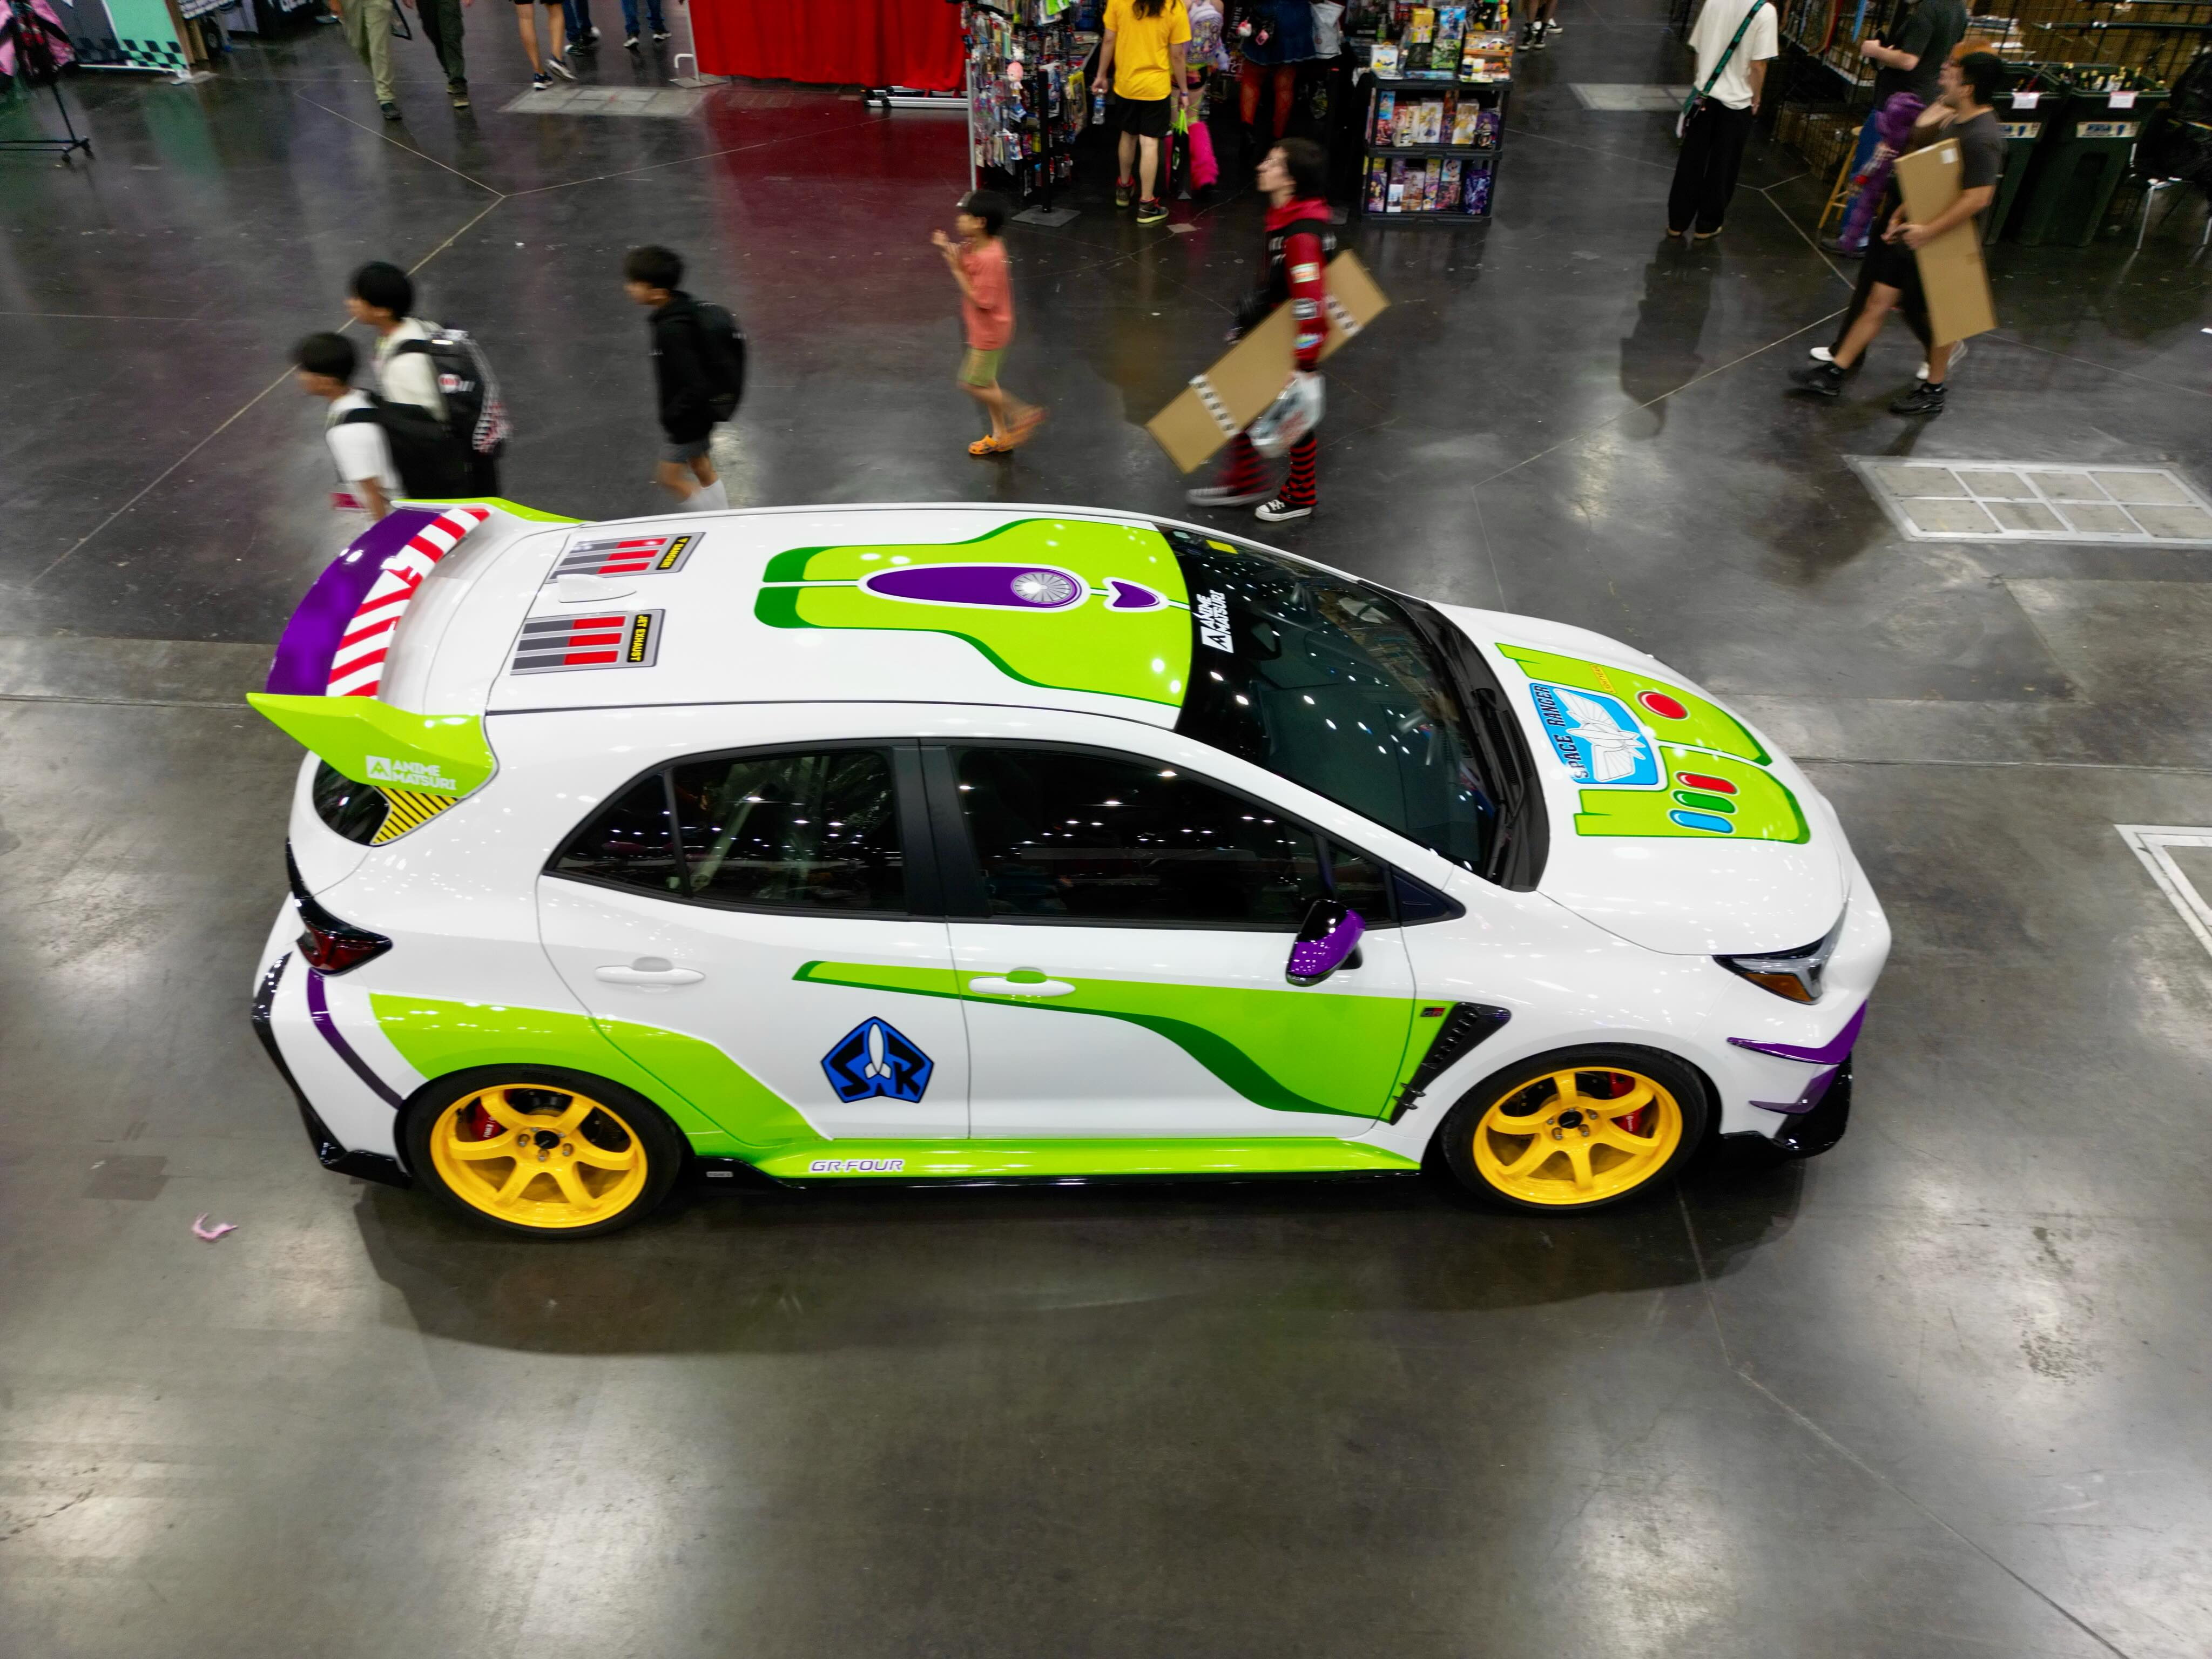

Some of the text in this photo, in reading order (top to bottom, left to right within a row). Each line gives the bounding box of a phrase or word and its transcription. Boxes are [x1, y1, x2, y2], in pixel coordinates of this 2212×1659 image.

[1192, 594, 1216, 629] ANIME
[1210, 589, 1232, 635] MATSURI
[630, 615, 648, 661] JET EXHAUST
[1534, 685, 1589, 778] SPACE RANGER
[393, 760, 441, 777] ANIME
[393, 771, 457, 790] MATSURI
